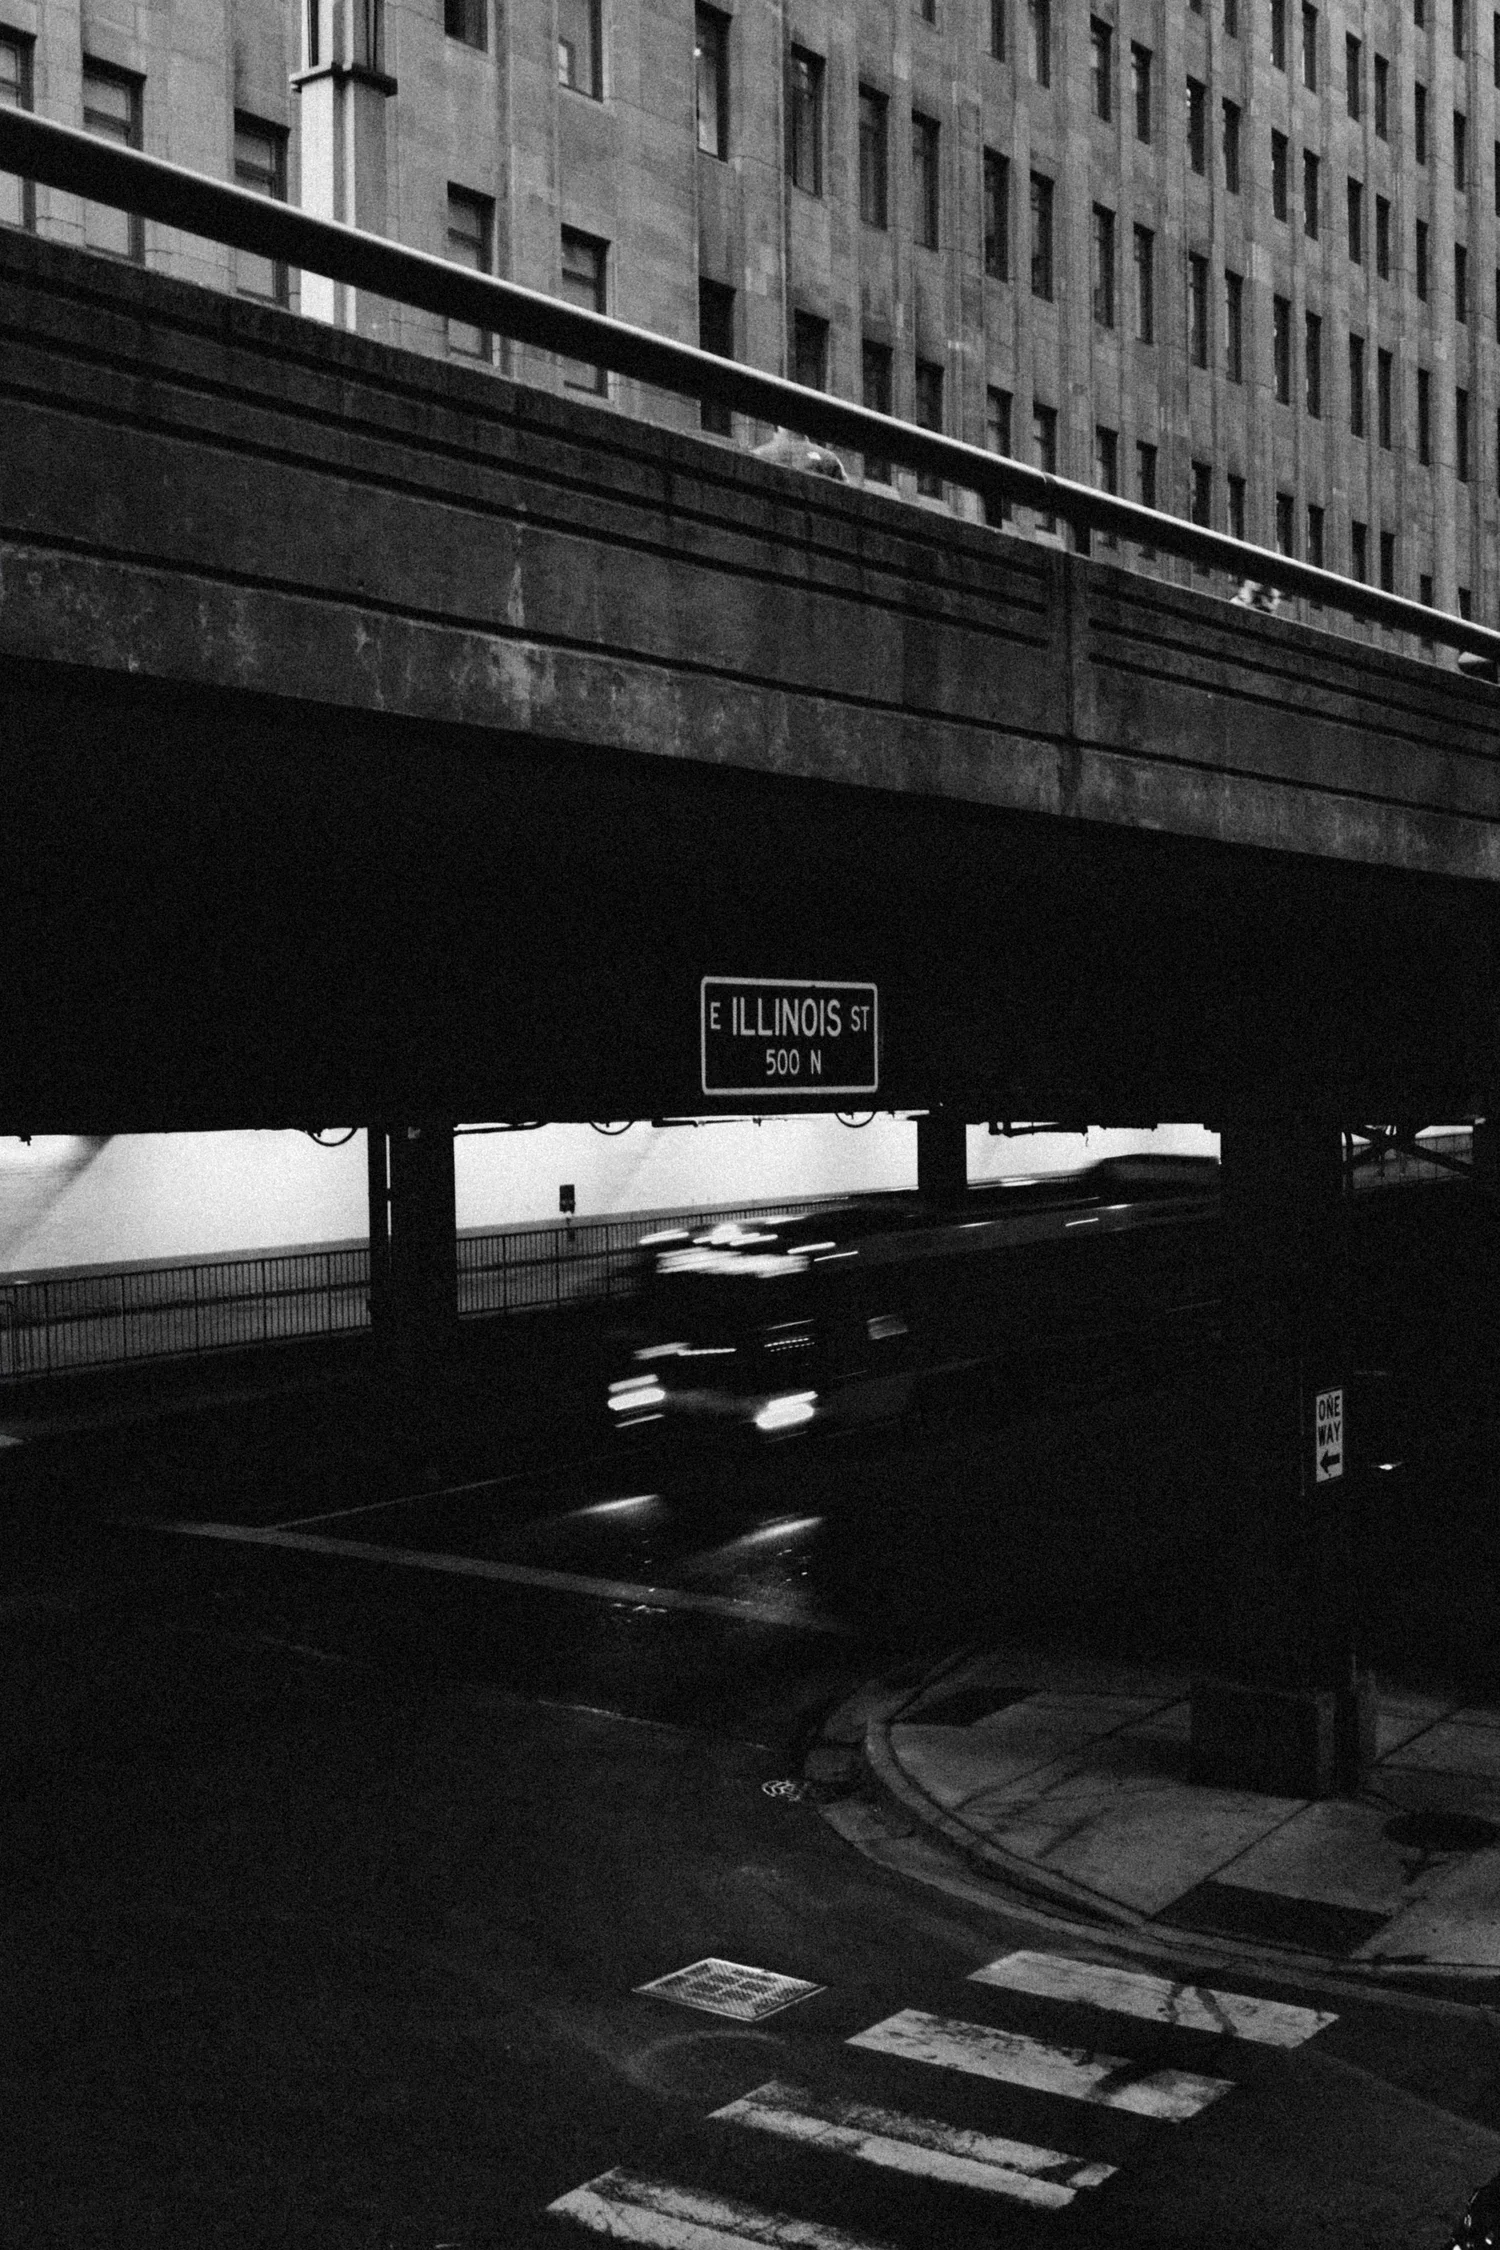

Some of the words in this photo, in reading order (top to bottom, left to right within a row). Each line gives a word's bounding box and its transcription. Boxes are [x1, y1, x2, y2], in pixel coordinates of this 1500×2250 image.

[710, 1001, 722, 1030] E
[732, 996, 842, 1037] ILLINOIS
[850, 1005, 870, 1032] ST
[765, 1048, 800, 1076] 500
[810, 1049, 822, 1075] N
[1318, 1395, 1341, 1421] ONE
[1318, 1421, 1341, 1446] WAY
